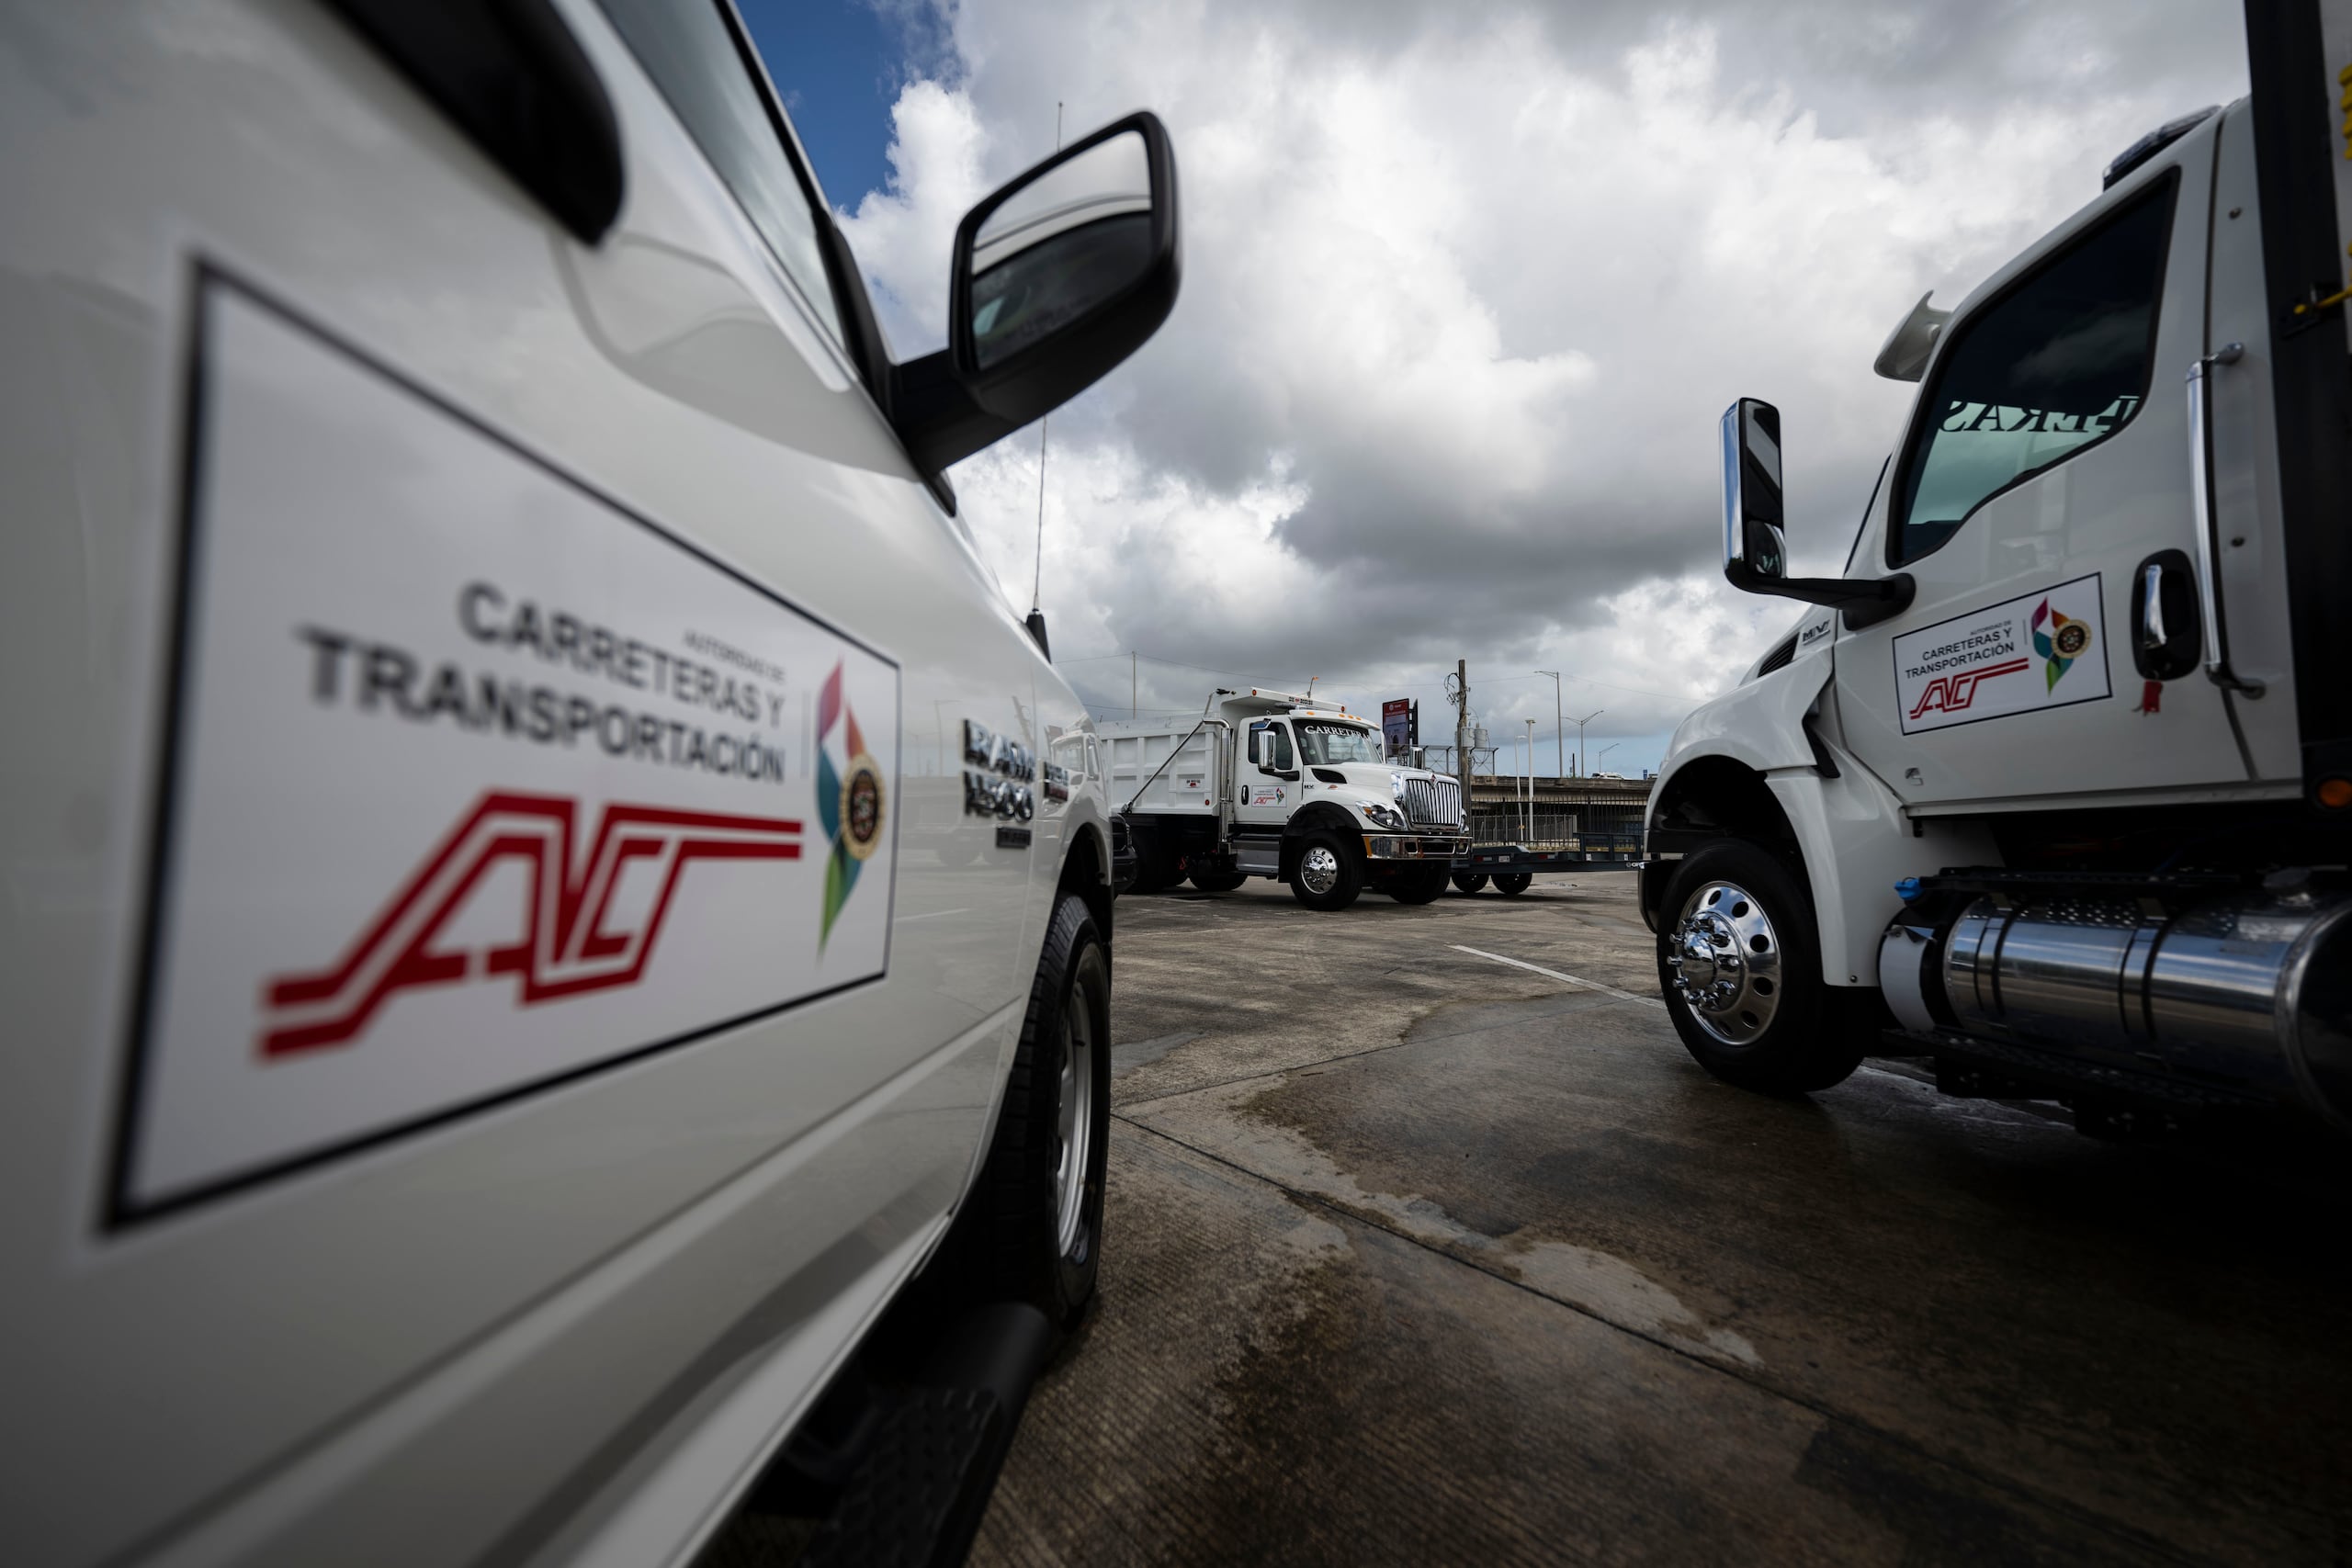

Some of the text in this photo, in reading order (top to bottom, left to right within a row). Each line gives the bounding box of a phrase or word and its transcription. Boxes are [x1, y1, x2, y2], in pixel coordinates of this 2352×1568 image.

[458, 580, 786, 728] CARRETERAS Y
[1905, 642, 2015, 679] TRANSPORTACIÓN
[1923, 627, 2013, 661] CARRETERAS Y
[294, 621, 785, 783] TRANSPORTACIÓN
